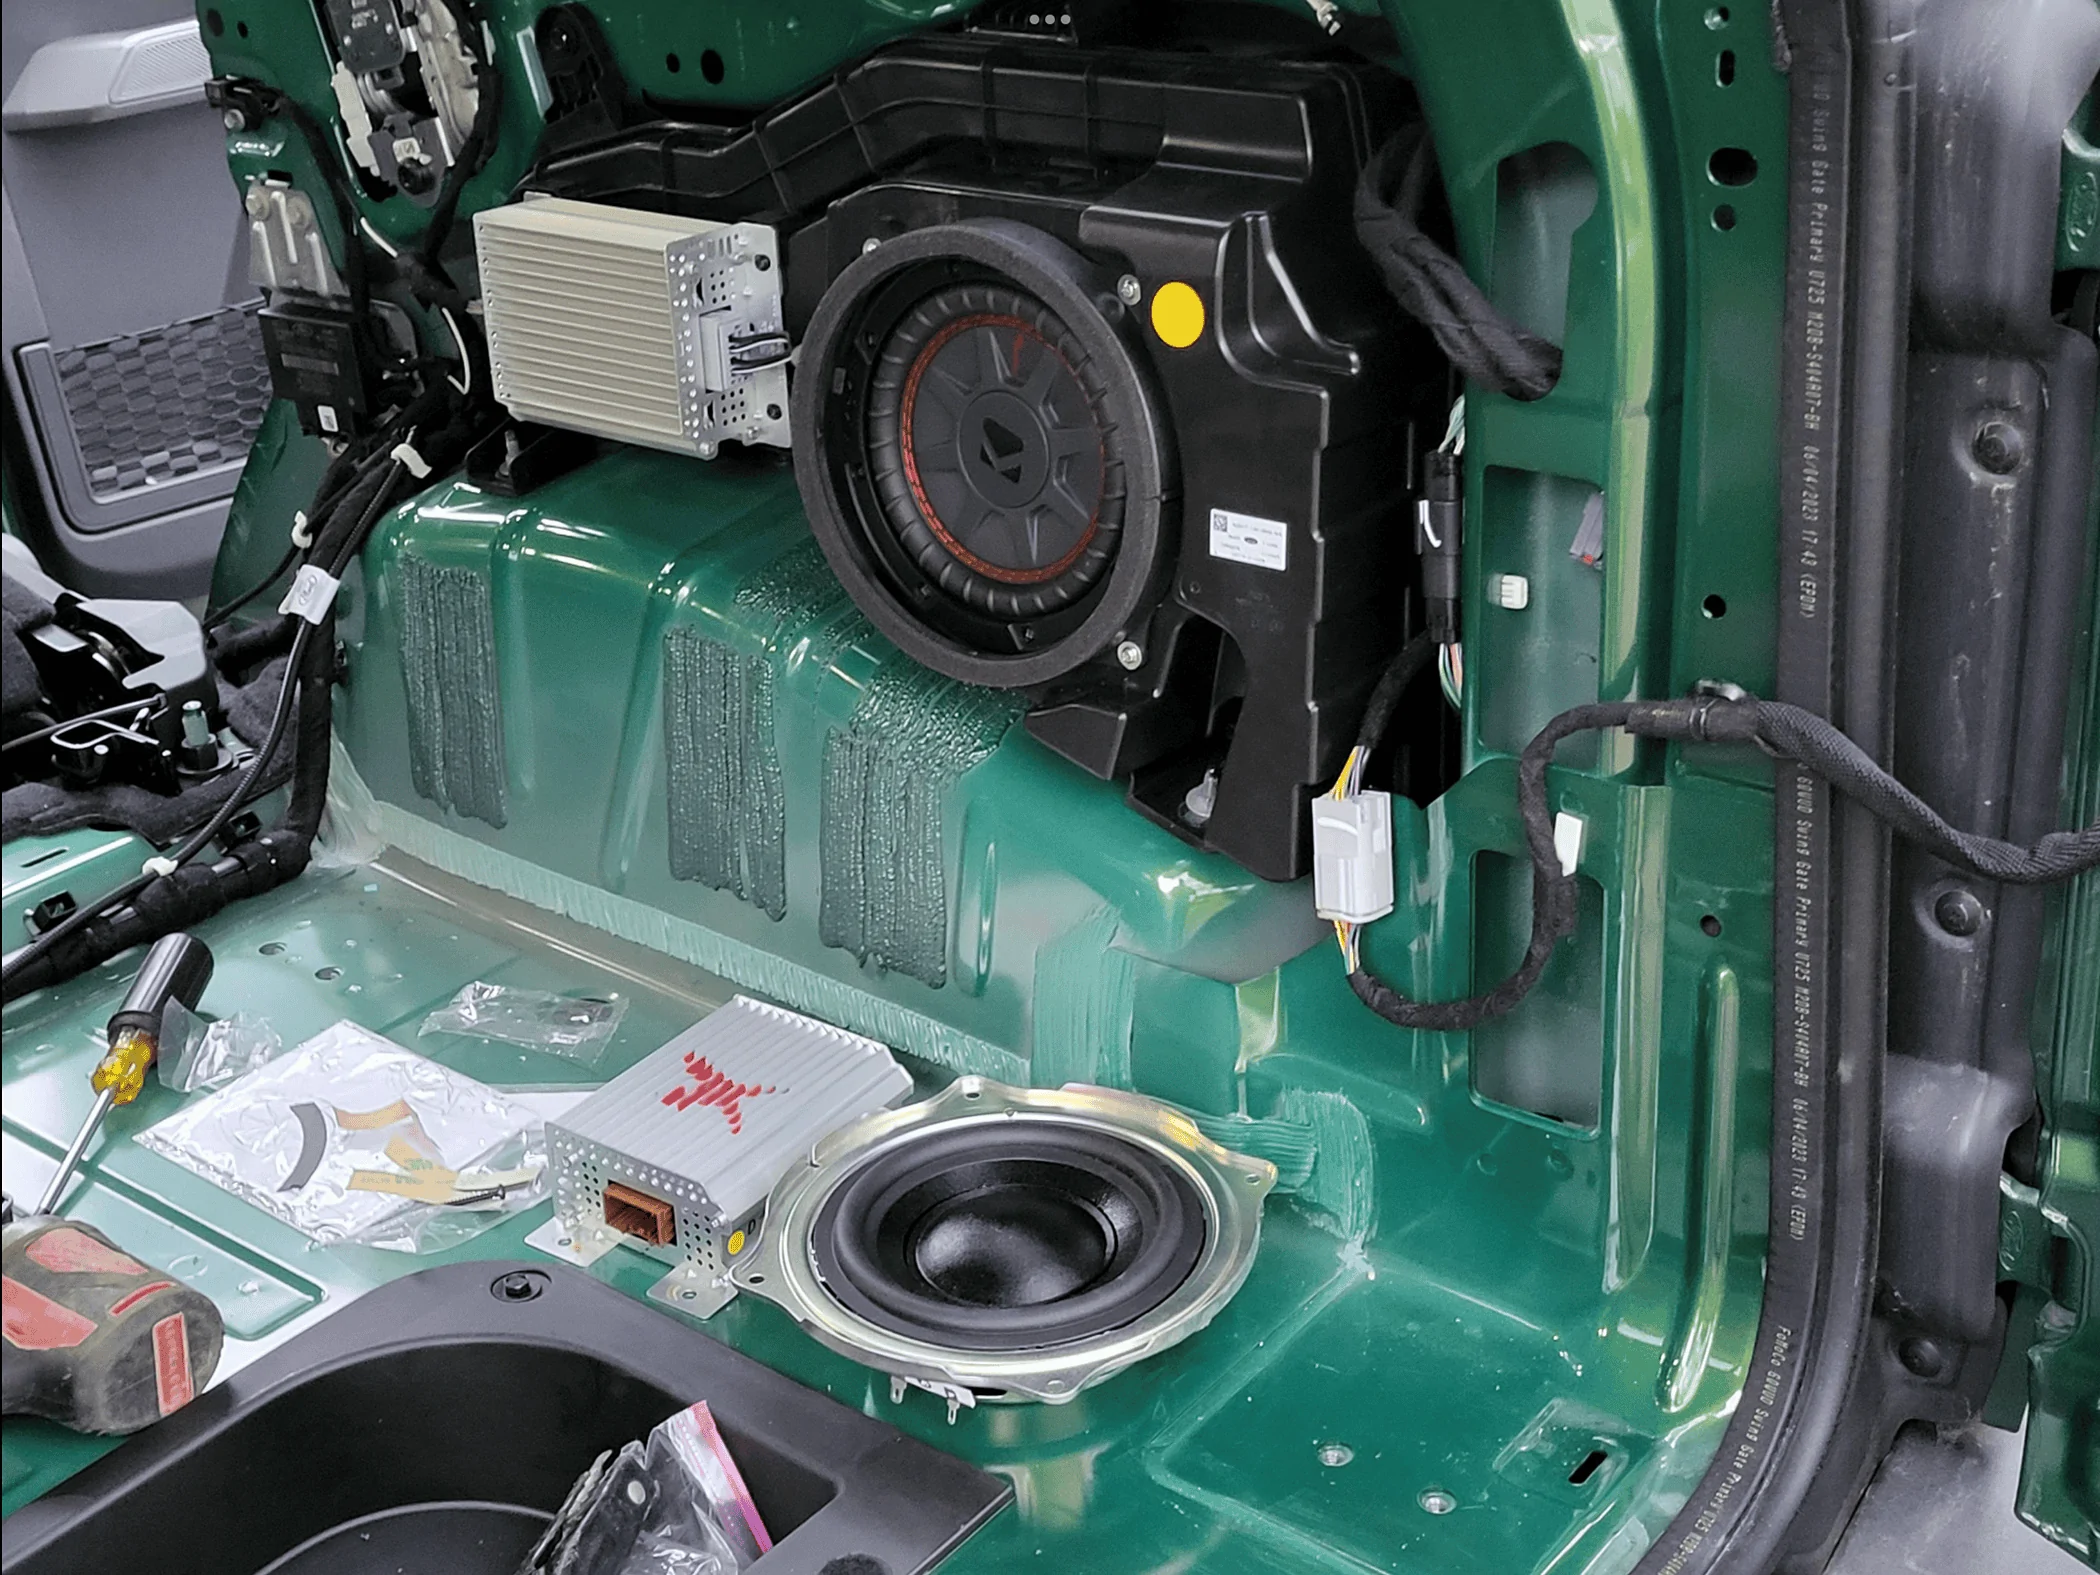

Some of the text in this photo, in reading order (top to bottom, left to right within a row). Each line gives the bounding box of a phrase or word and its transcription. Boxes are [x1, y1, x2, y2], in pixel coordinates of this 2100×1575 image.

[1812, 109, 1830, 151] Swing
[1810, 160, 1829, 194] Gate
[1809, 202, 1828, 262] Primary
[1806, 269, 1827, 305] U725
[1795, 819, 1813, 856] Swing
[1795, 861, 1812, 890] Gate
[1793, 896, 1812, 946] Primary
[1793, 951, 1811, 982] U725
[1770, 1325, 1792, 1367] FoMoCo
[1745, 1408, 1770, 1442] Swing
[1732, 1444, 1755, 1469] Gate
[1709, 1471, 1743, 1511] Primary
